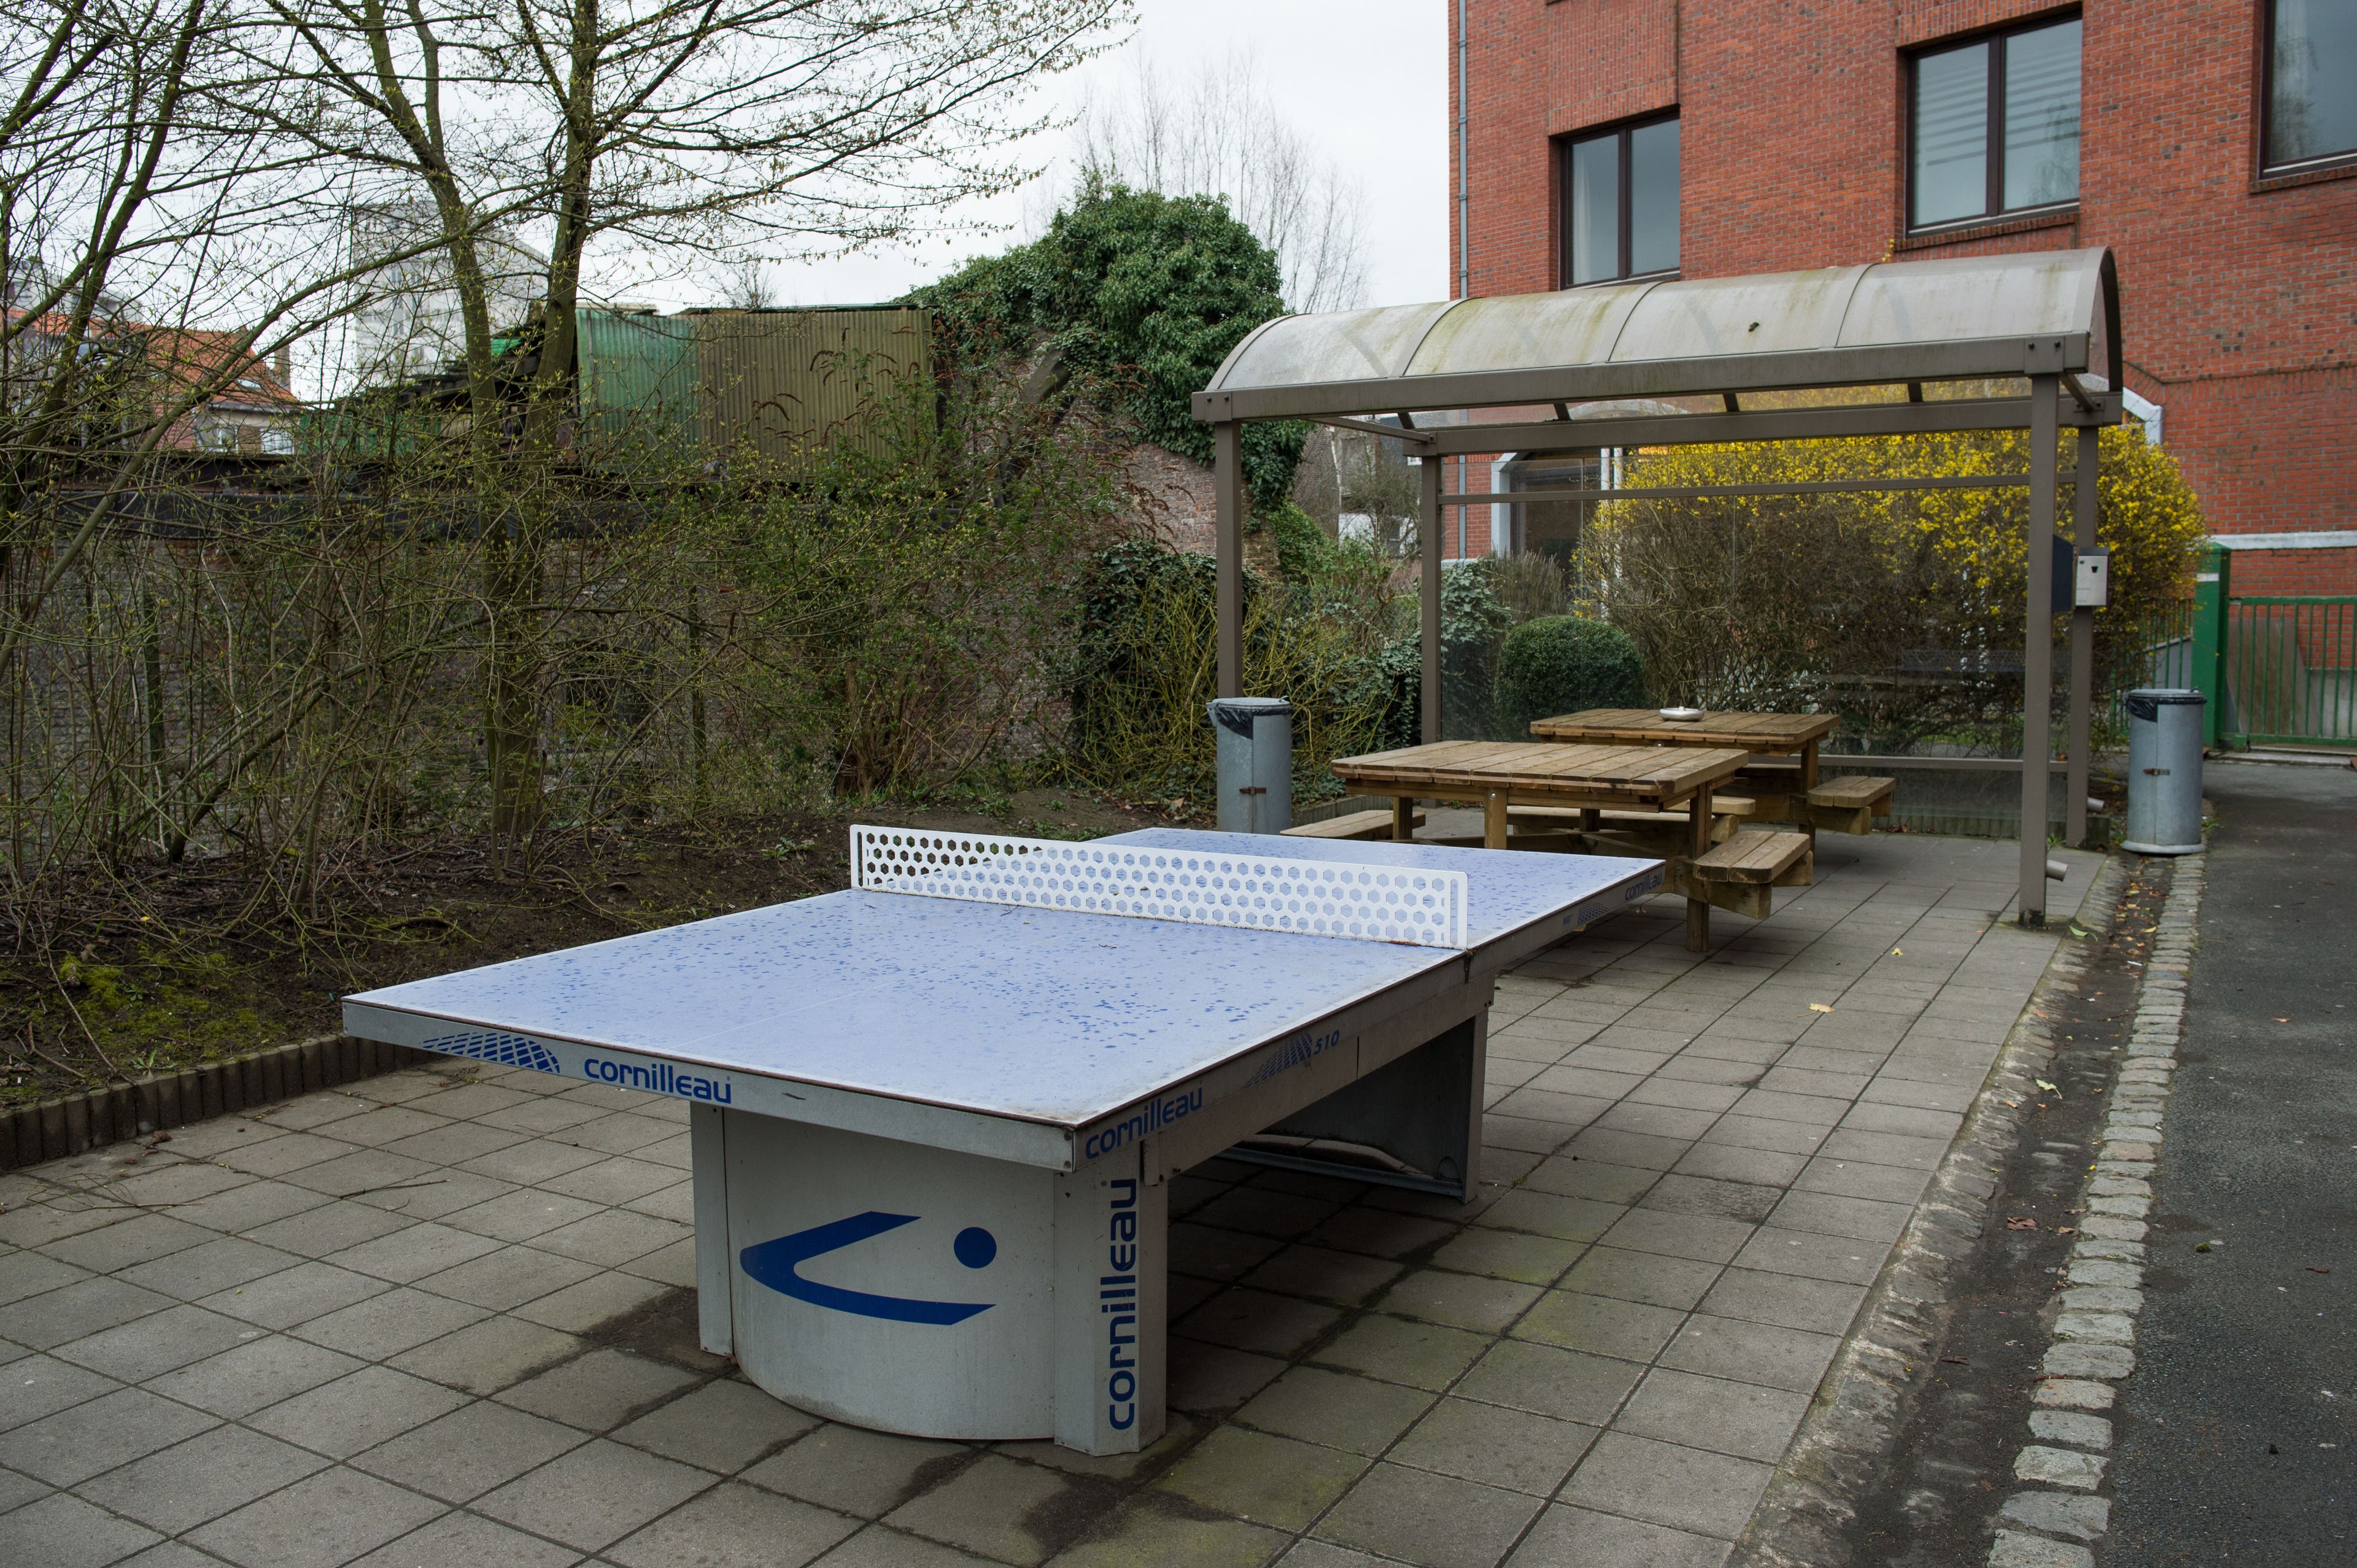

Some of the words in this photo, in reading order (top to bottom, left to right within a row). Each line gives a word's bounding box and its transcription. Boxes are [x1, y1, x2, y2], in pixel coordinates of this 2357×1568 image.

[1625, 873, 1662, 901] cornilleau
[1313, 1029, 1340, 1056] 510
[584, 1058, 731, 1104] cornilleau
[1085, 1087, 1203, 1159] cornilleau
[1100, 1179, 1137, 1430] cornilleau
